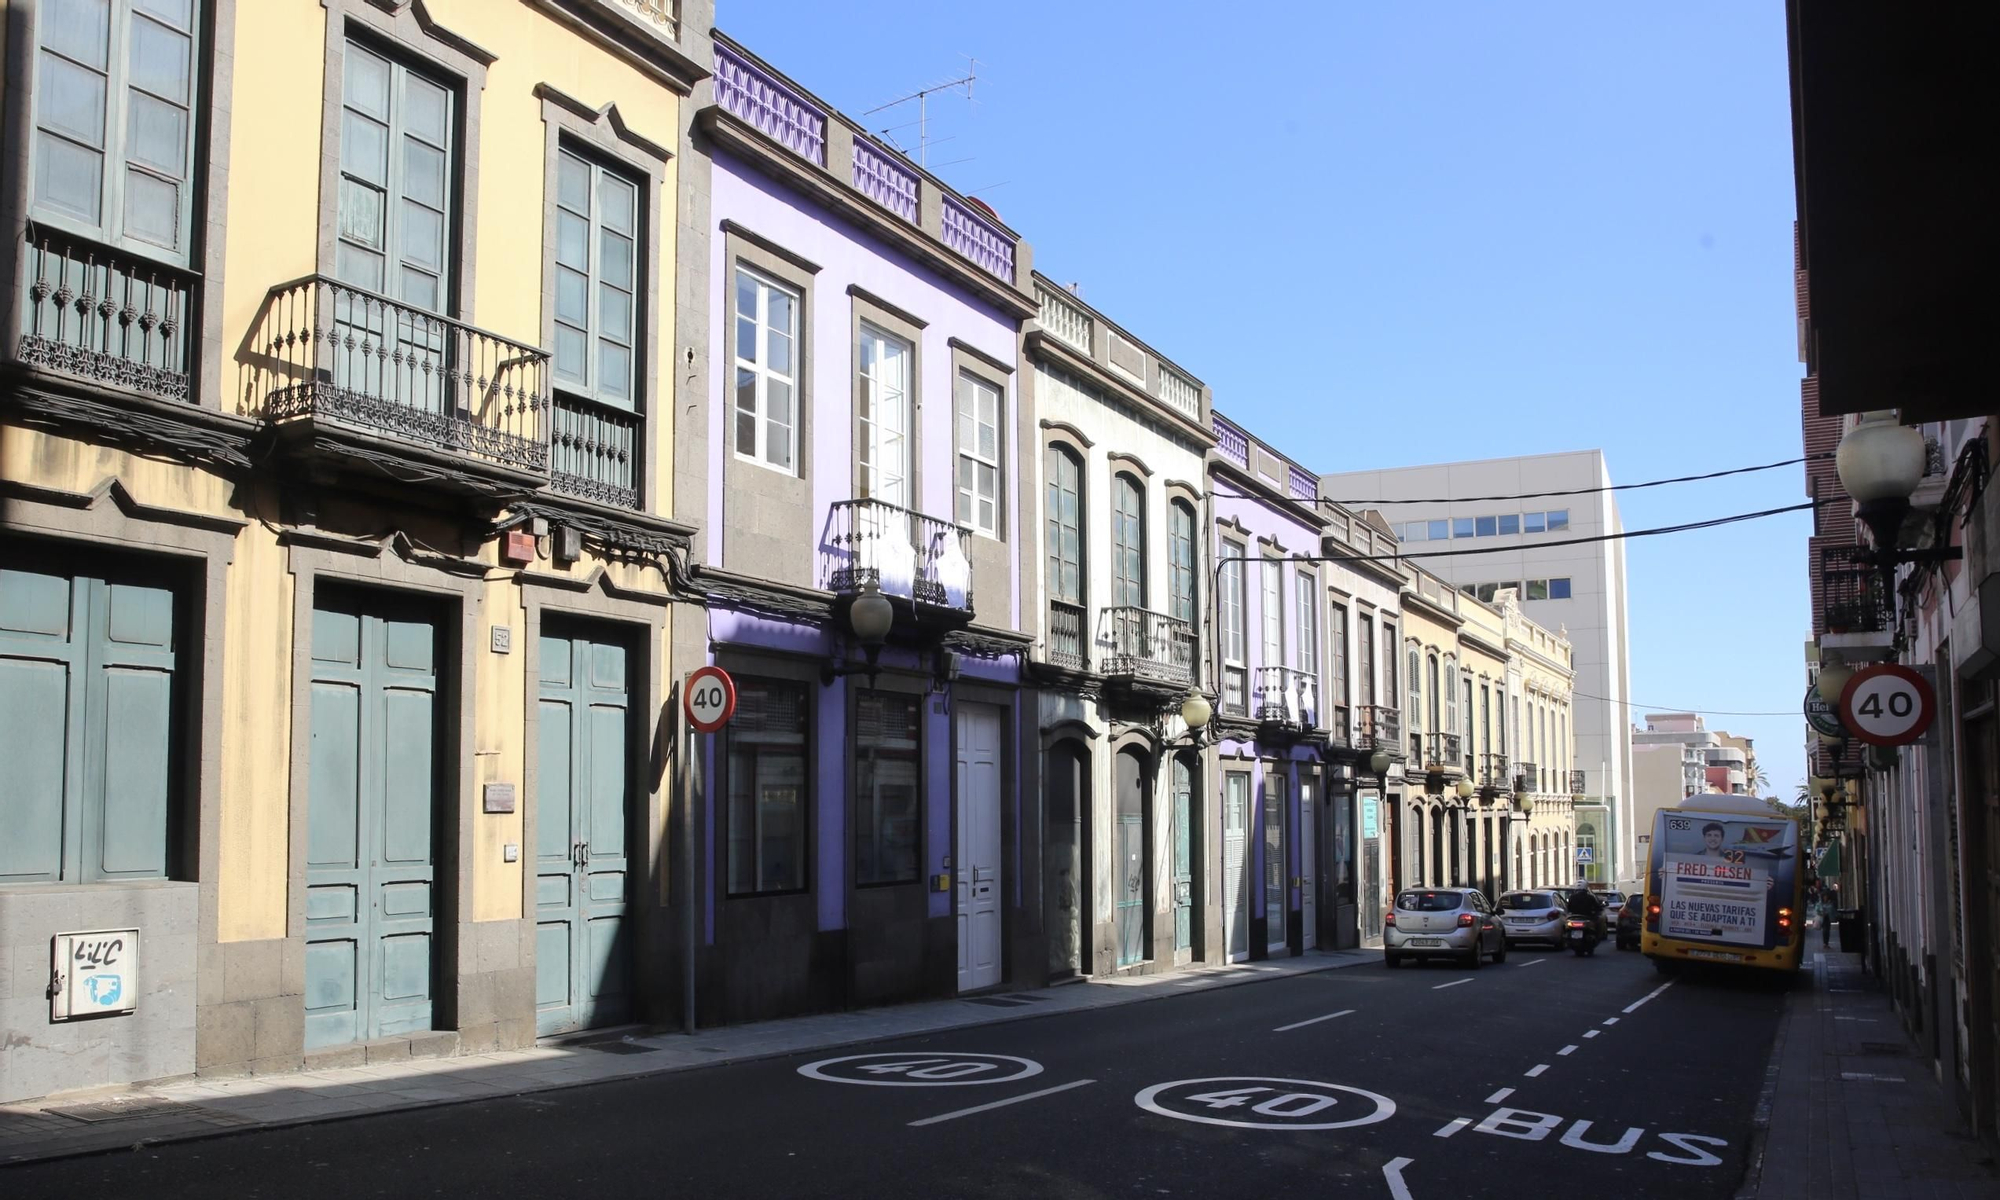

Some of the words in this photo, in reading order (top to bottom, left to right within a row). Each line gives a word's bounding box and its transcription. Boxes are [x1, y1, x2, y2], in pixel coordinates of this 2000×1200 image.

[495, 634, 508, 647] 52
[693, 687, 722, 709] 40
[1858, 691, 1913, 719] 40
[1670, 820, 1691, 830] 639
[1723, 849, 1745, 864] 32
[1714, 865, 1752, 880] OLSEN
[1671, 900, 1686, 910] LAS
[1688, 902, 1720, 913] NUEVAS
[1722, 904, 1756, 916] TARIFAS
[1670, 910, 1685, 920] QUE
[1688, 912, 1698, 921] SE
[1700, 913, 1738, 925] ADAPTAN
[1740, 917, 1746, 926] A
[1747, 917, 1756, 926] TI
[855, 1058, 998, 1079] 40
[1184, 1086, 1339, 1117] 40
[1472, 1106, 1729, 1166] BUS
